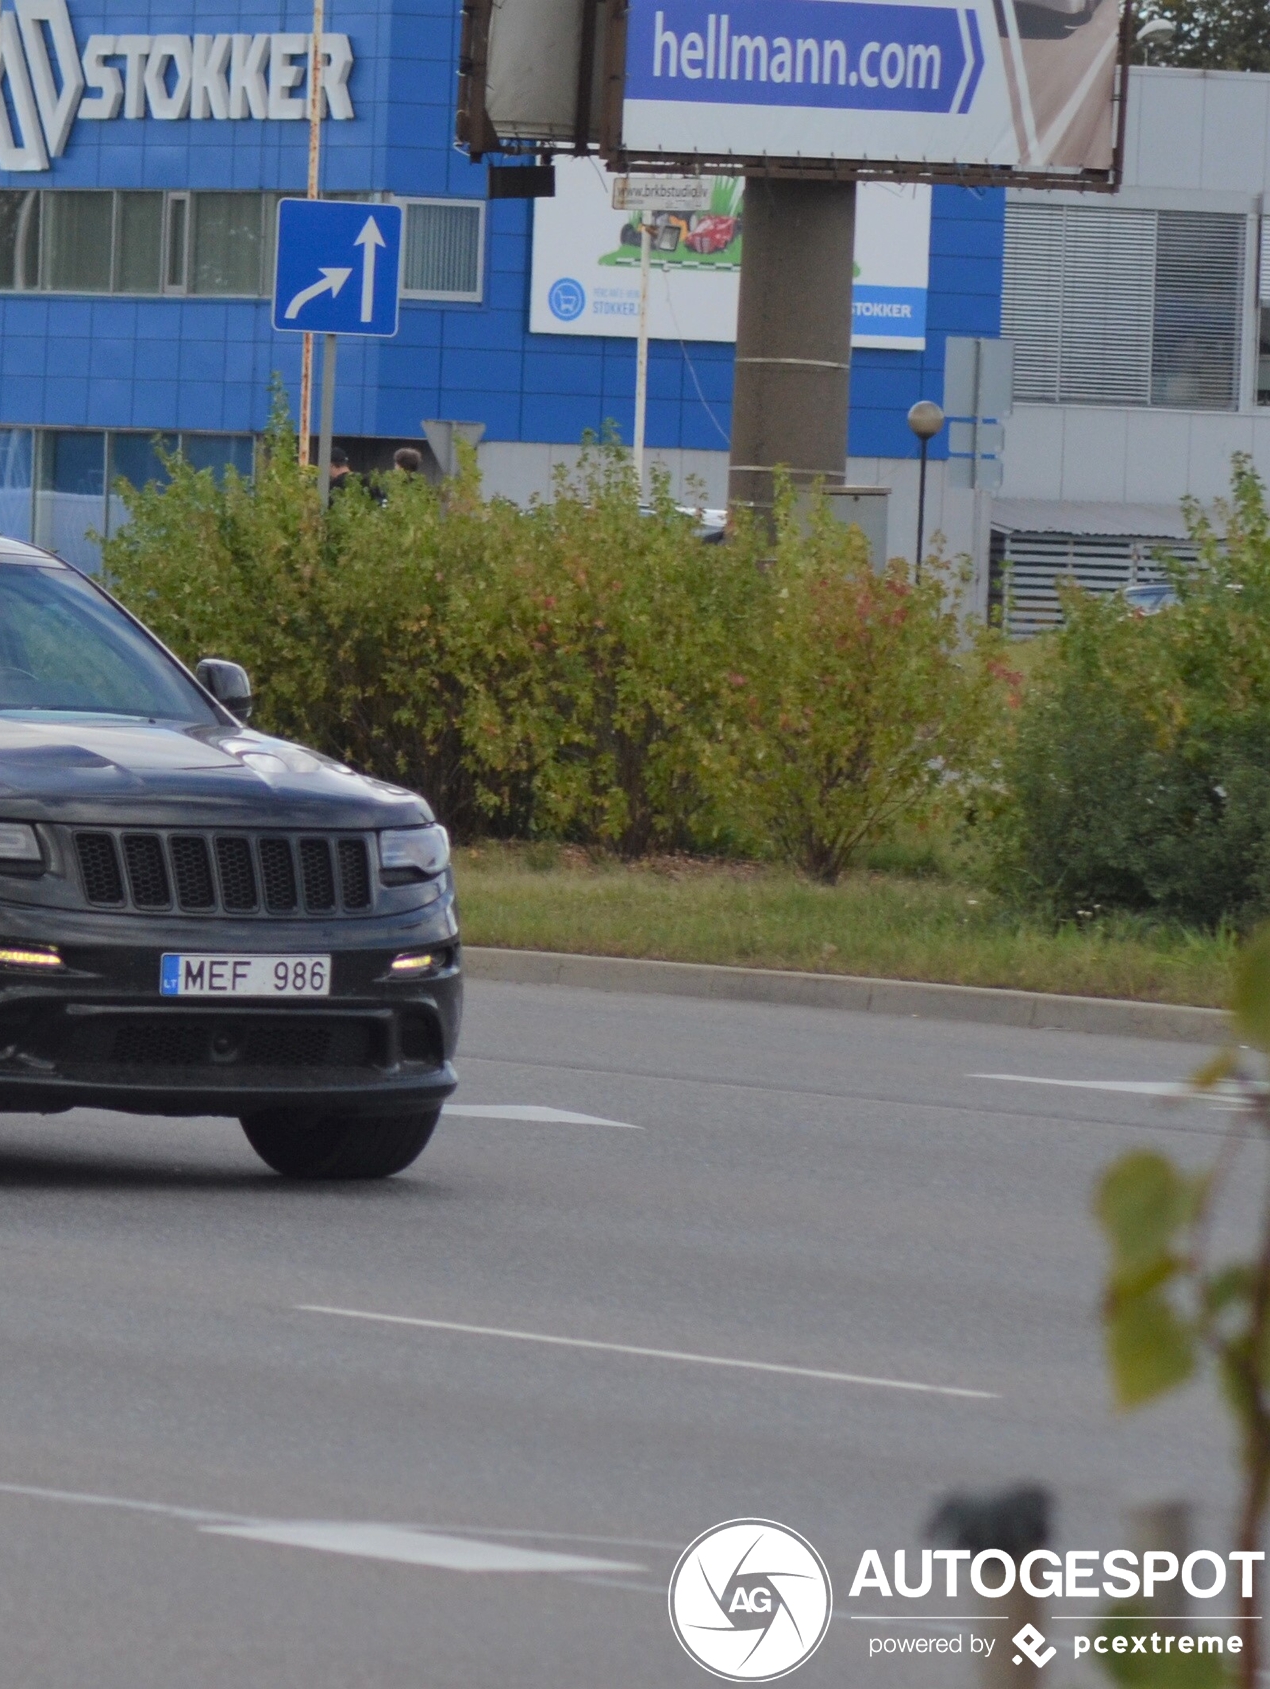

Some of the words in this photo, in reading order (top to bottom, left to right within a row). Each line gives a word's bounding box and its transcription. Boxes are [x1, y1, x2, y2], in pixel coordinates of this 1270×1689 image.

[77, 32, 355, 121] STOKKER
[652, 10, 942, 90] hellmann.com
[163, 979, 177, 989] LT
[184, 960, 252, 991] MEF
[273, 961, 324, 991] 986
